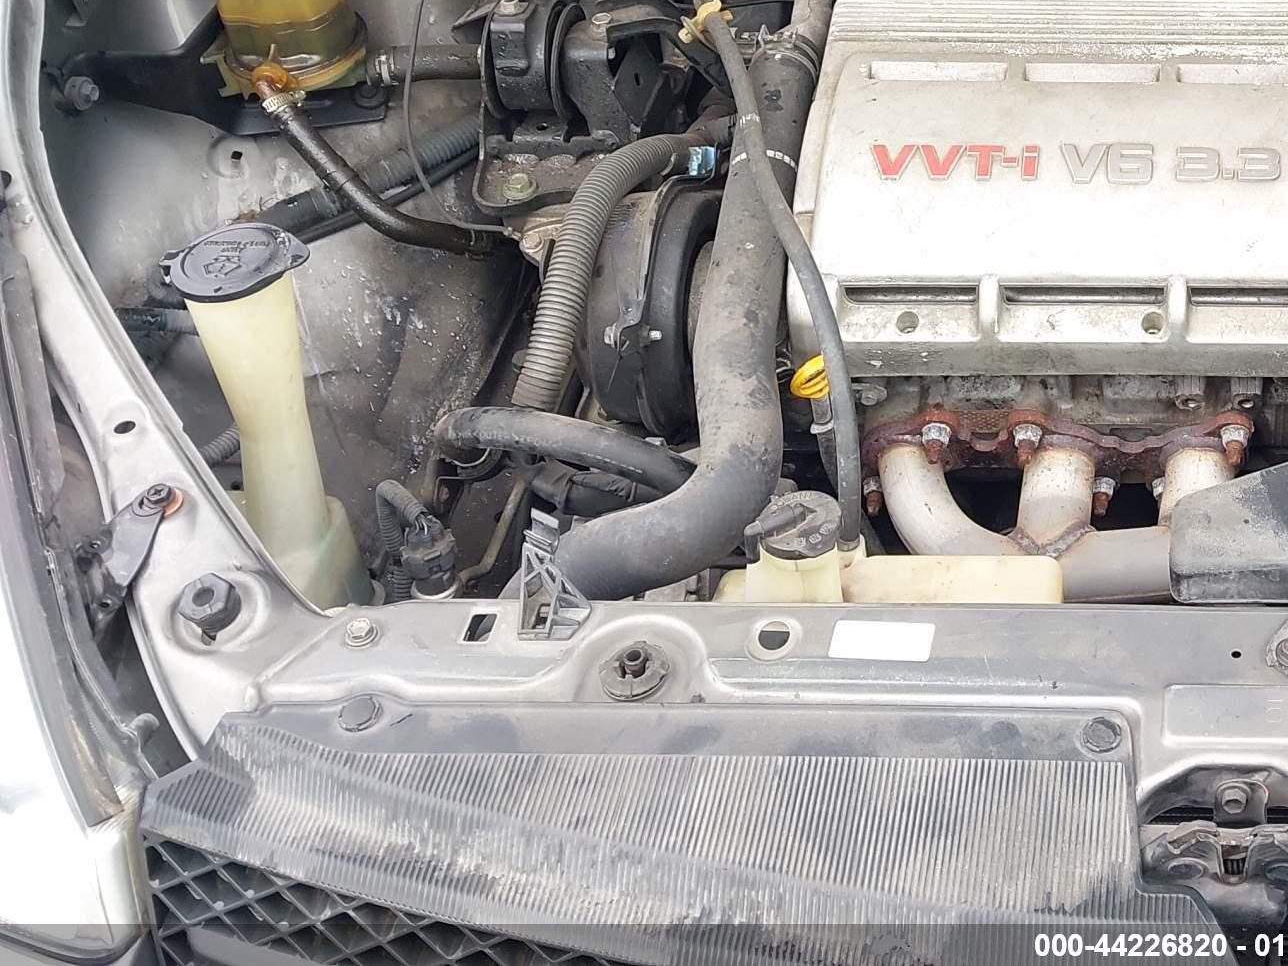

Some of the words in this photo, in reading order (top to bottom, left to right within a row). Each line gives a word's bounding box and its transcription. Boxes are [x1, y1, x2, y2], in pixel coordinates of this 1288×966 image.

[871, 144, 1040, 180] VVT-i
[1060, 143, 1154, 185] V6
[1175, 146, 1282, 183] 3.3
